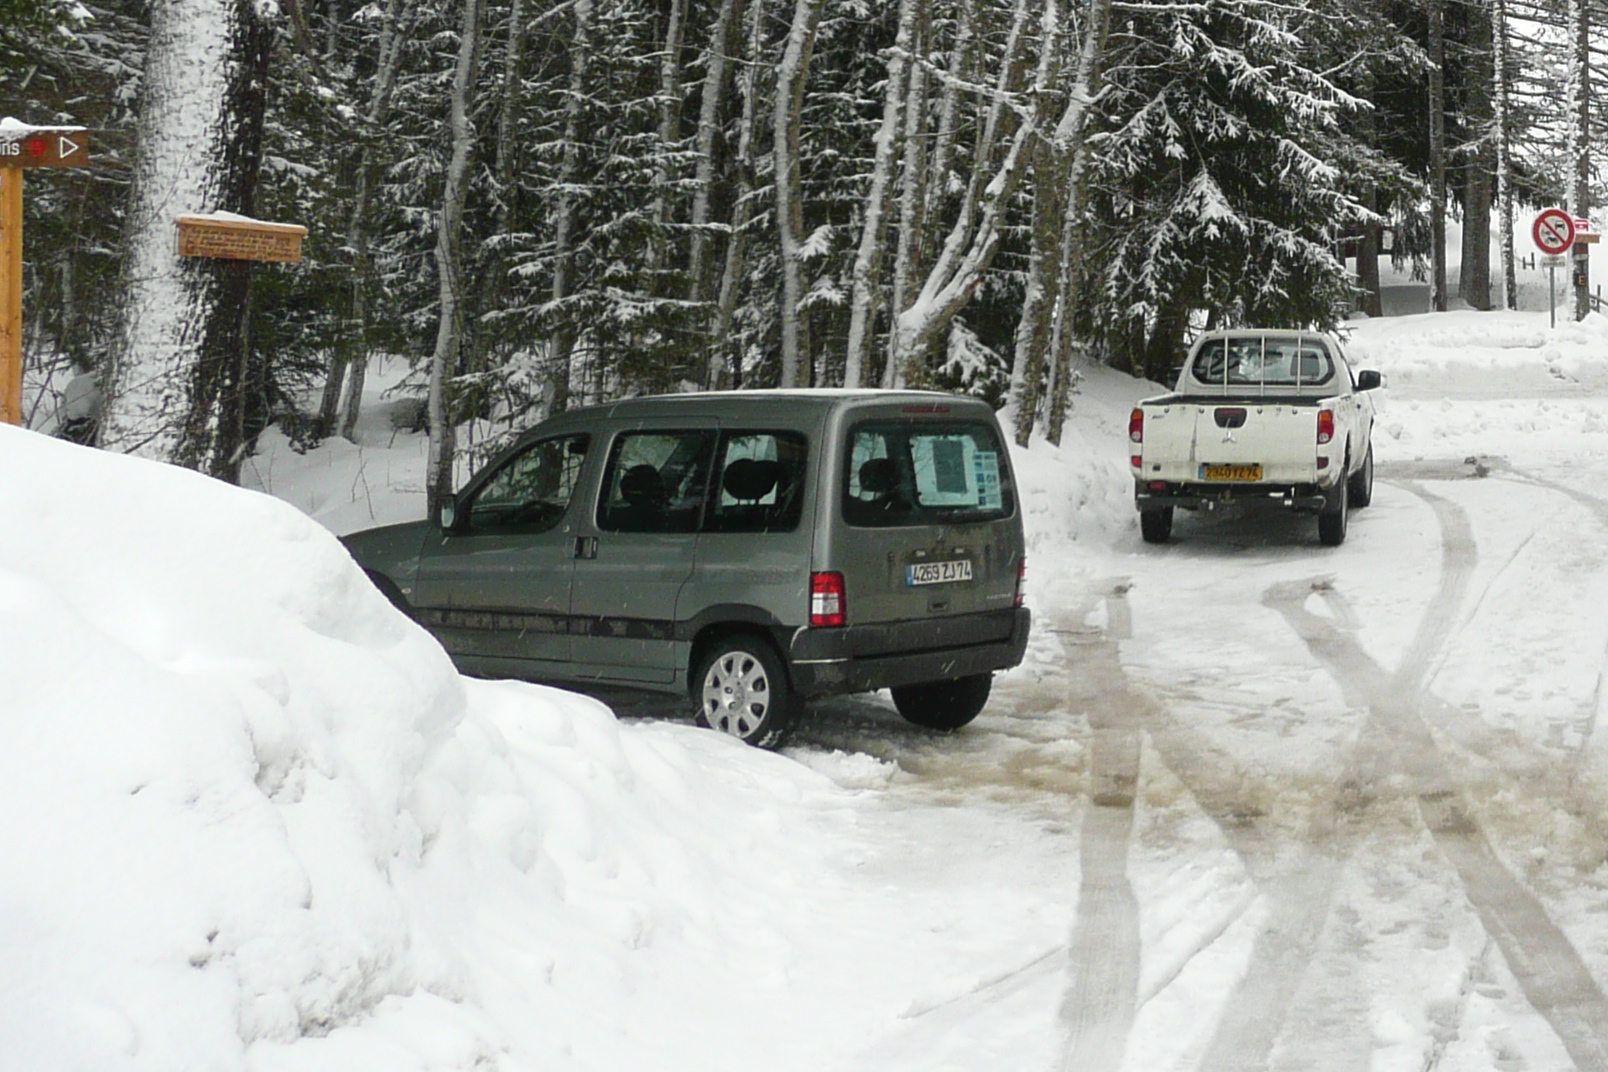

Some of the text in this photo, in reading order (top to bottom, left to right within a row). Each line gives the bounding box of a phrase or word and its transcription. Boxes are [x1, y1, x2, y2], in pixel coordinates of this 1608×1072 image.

[0, 142, 20, 156] ns
[913, 561, 970, 582] 4269 ZJ 74
